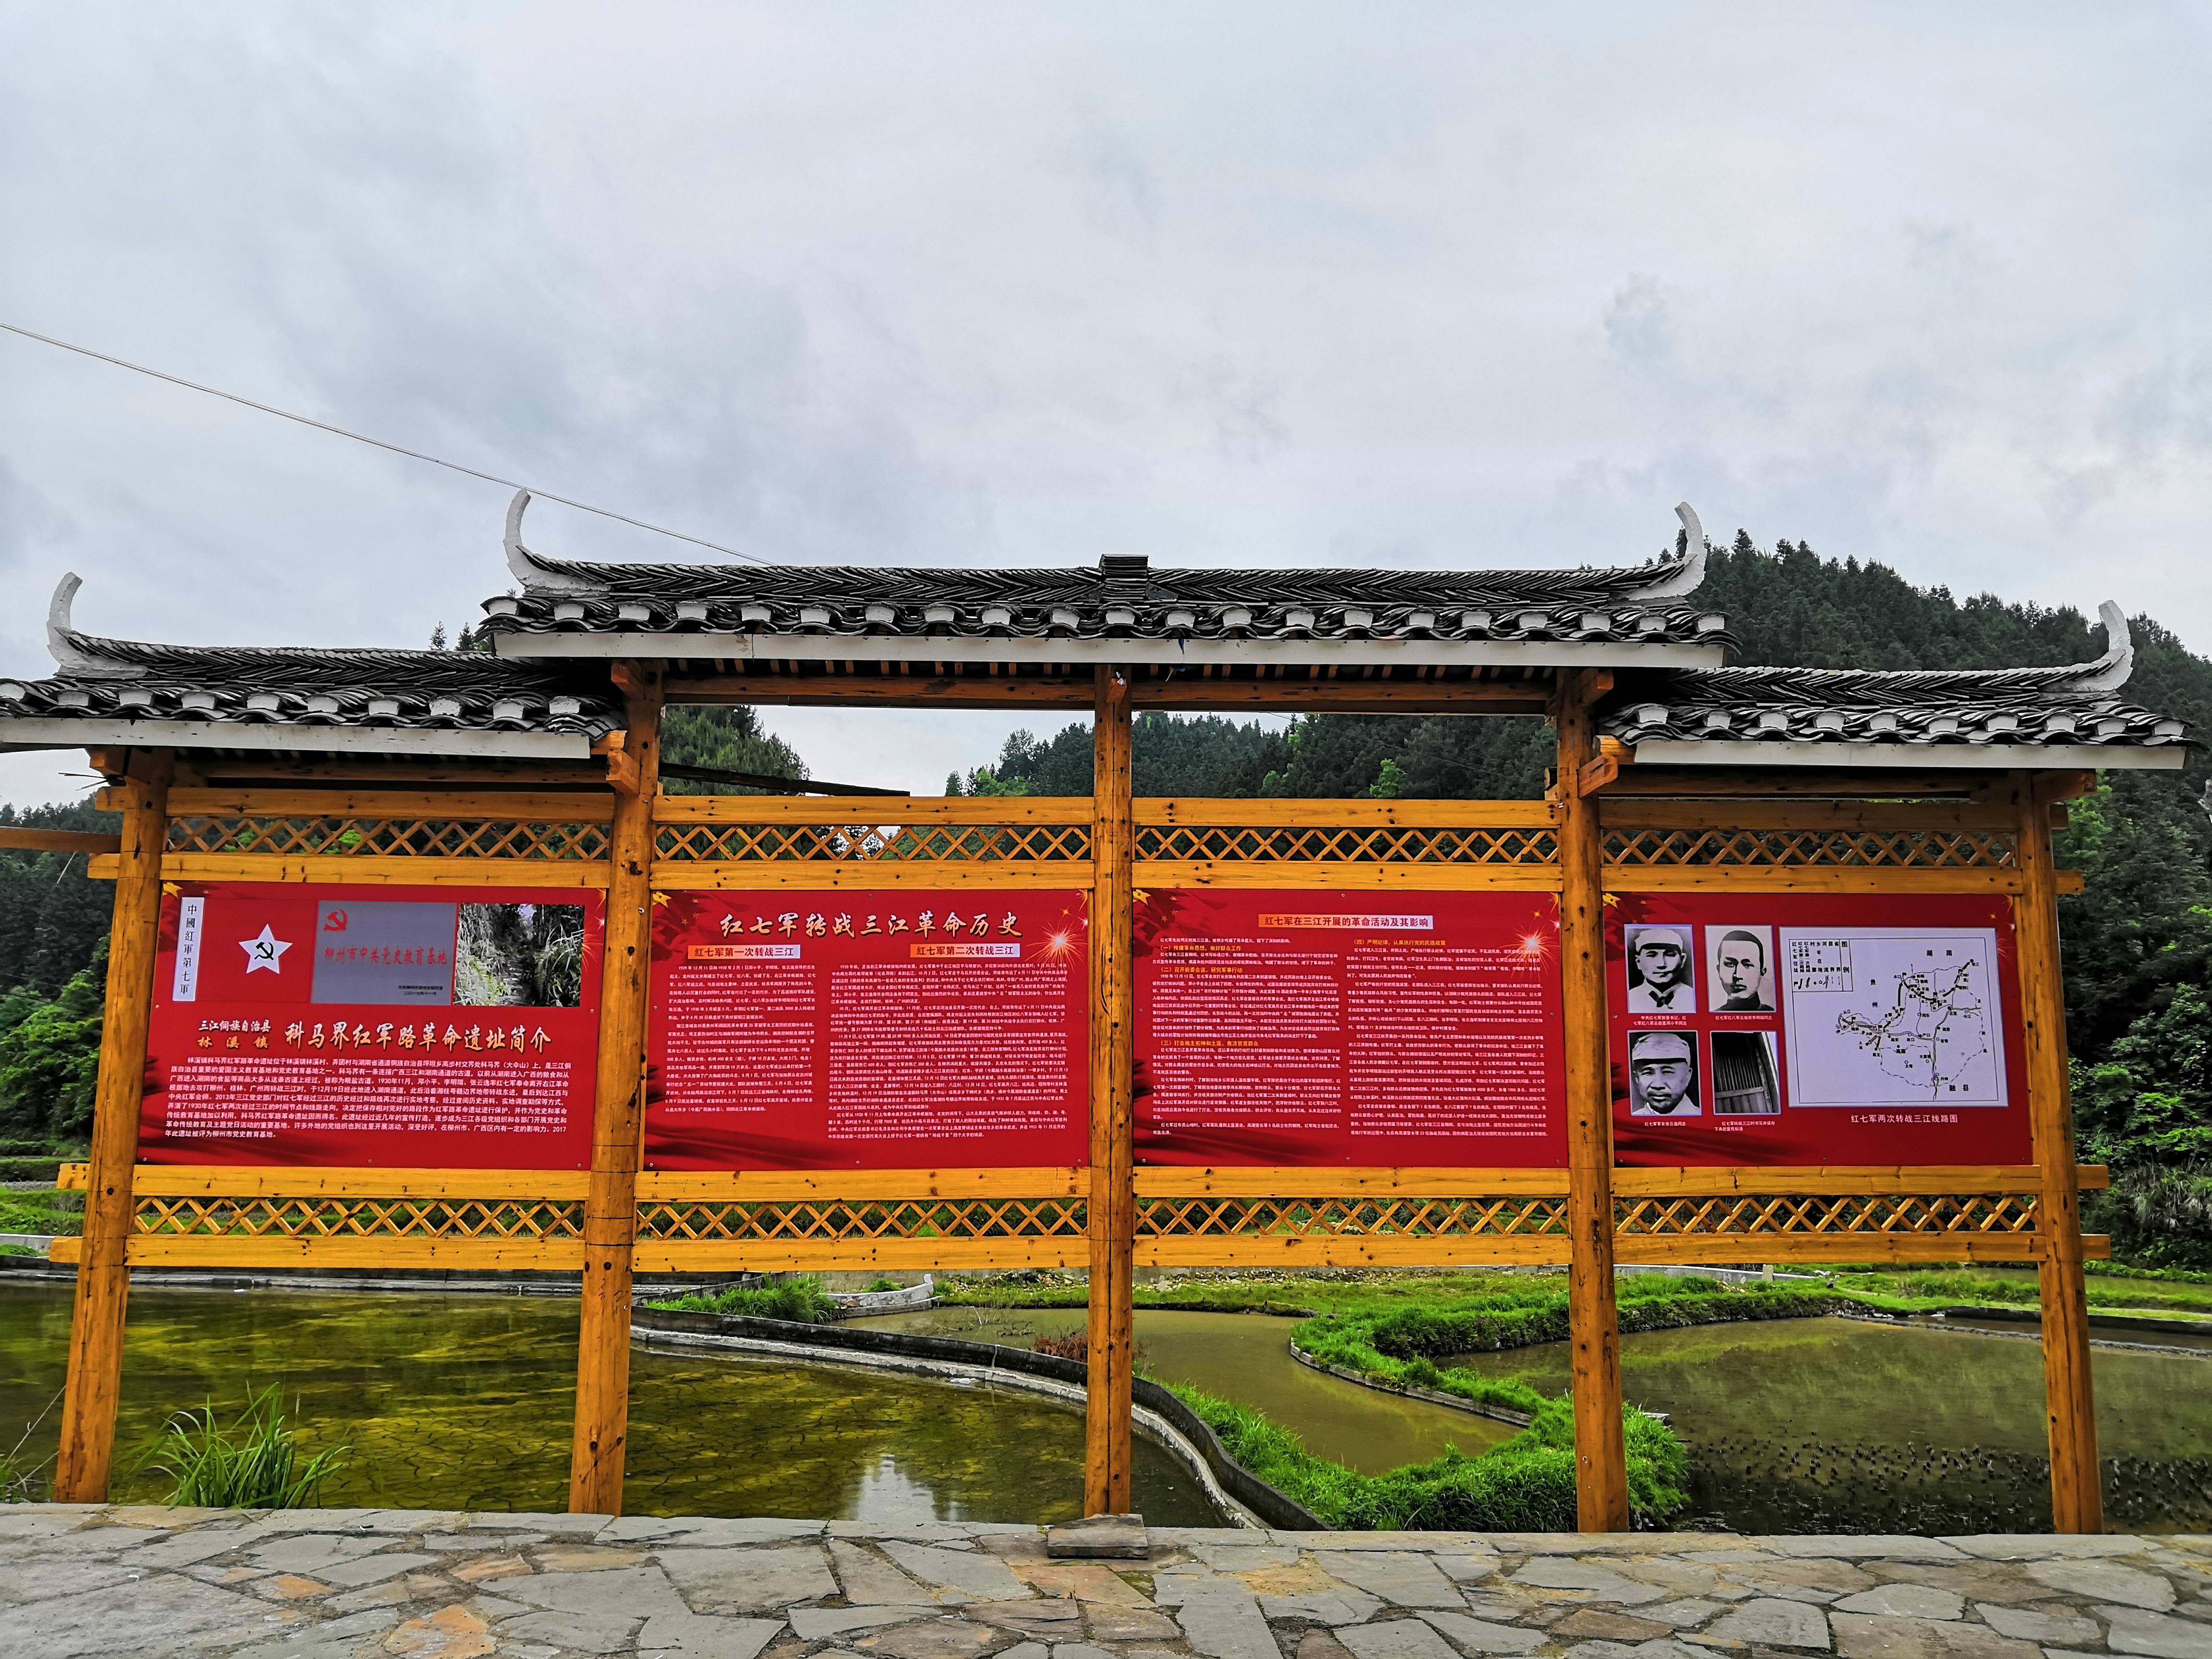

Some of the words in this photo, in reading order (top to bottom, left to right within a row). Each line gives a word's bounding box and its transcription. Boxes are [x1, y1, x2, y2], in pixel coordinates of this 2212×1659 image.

[720, 910, 1022, 938] 红七军转战三江革命历史
[1265, 916, 1429, 927] 红七军在三江开展的革命活动及其影响
[694, 947, 794, 957] 红七军第一次转战三江
[916, 946, 1014, 955] 红七军第二次转战三江
[198, 1019, 271, 1033] 三江侗族自治县
[285, 1021, 552, 1054] 科马界红军路革命遗址简介
[1851, 1114, 1958, 1123] 红七军两次转战三江线路图
